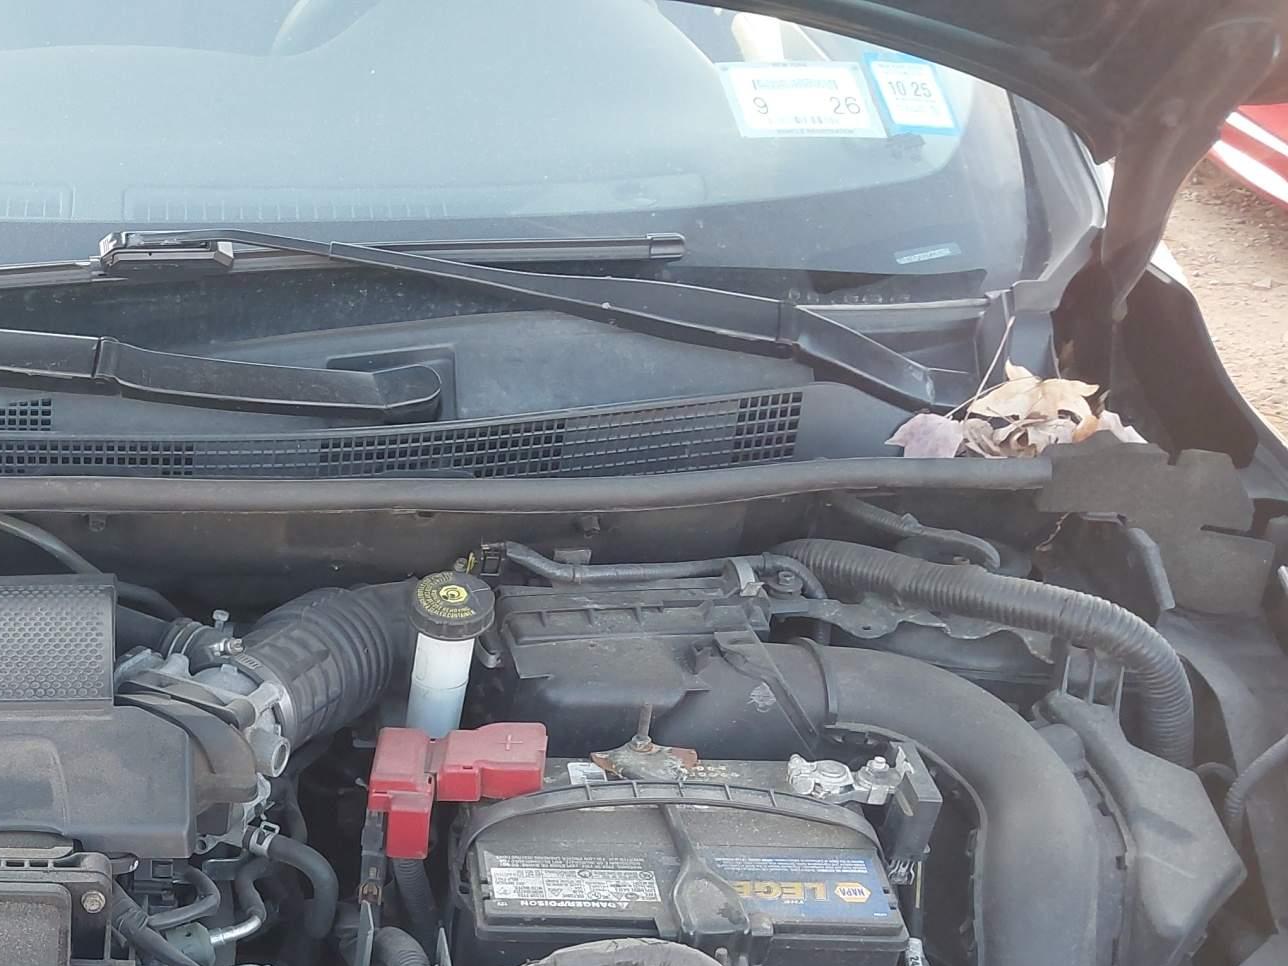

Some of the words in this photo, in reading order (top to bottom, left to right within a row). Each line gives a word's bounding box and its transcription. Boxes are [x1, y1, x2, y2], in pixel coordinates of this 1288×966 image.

[888, 80, 907, 96] 10
[910, 81, 932, 98] 25
[752, 96, 769, 115] 9
[829, 96, 861, 115] 26
[726, 880, 829, 901] LEGE
[838, 887, 865, 897] NAPA
[520, 900, 616, 909] DANGER/POISON
